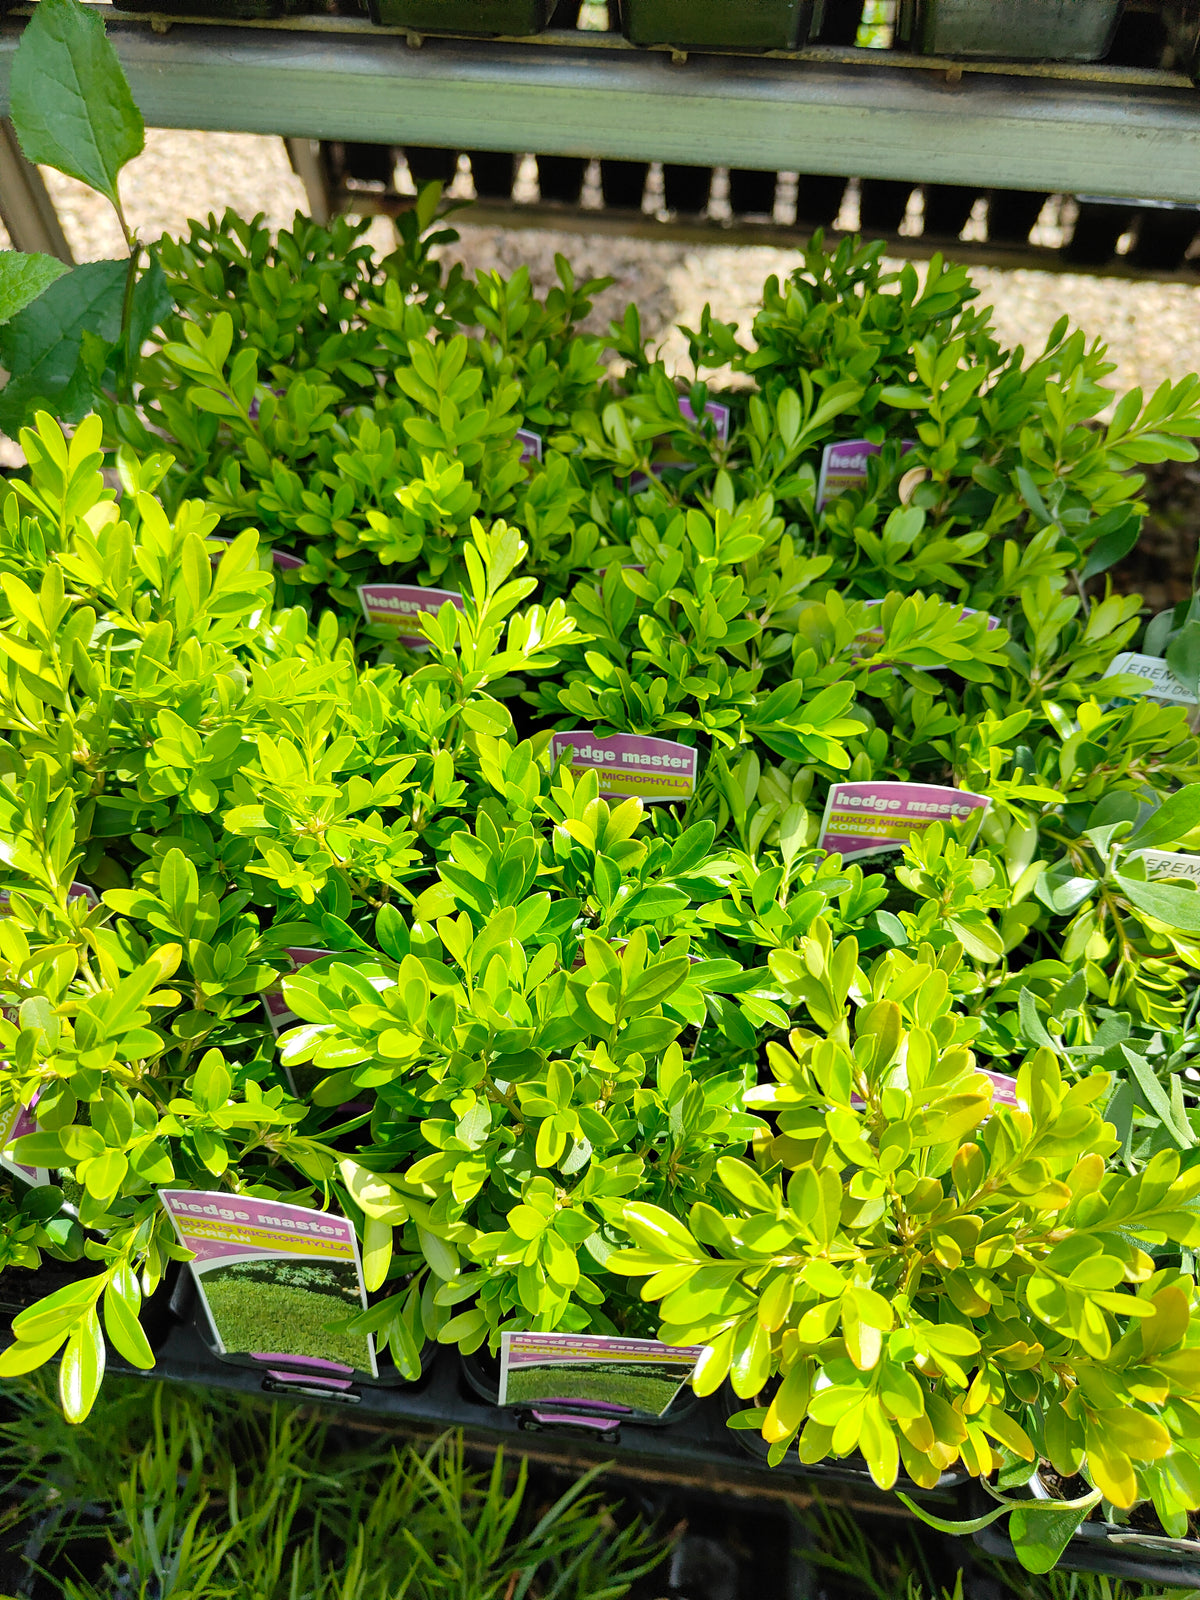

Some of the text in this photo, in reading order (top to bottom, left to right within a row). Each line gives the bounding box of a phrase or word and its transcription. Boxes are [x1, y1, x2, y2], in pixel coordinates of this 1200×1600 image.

[366, 593, 420, 613] hedge
[1126, 664, 1177, 682] EREM
[556, 742, 691, 769] hedge master
[602, 772, 690, 788] MICROPHYLLA
[836, 792, 974, 816] hedge maste
[828, 822, 887, 834] KOREAN
[831, 815, 931, 830] BUXUS MICROP
[170, 1198, 346, 1237] hedge master
[179, 1219, 350, 1253] BUXUS MICROPHYLLA
[181, 1225, 251, 1243] KOREAN
[515, 1336, 600, 1348] hedge
